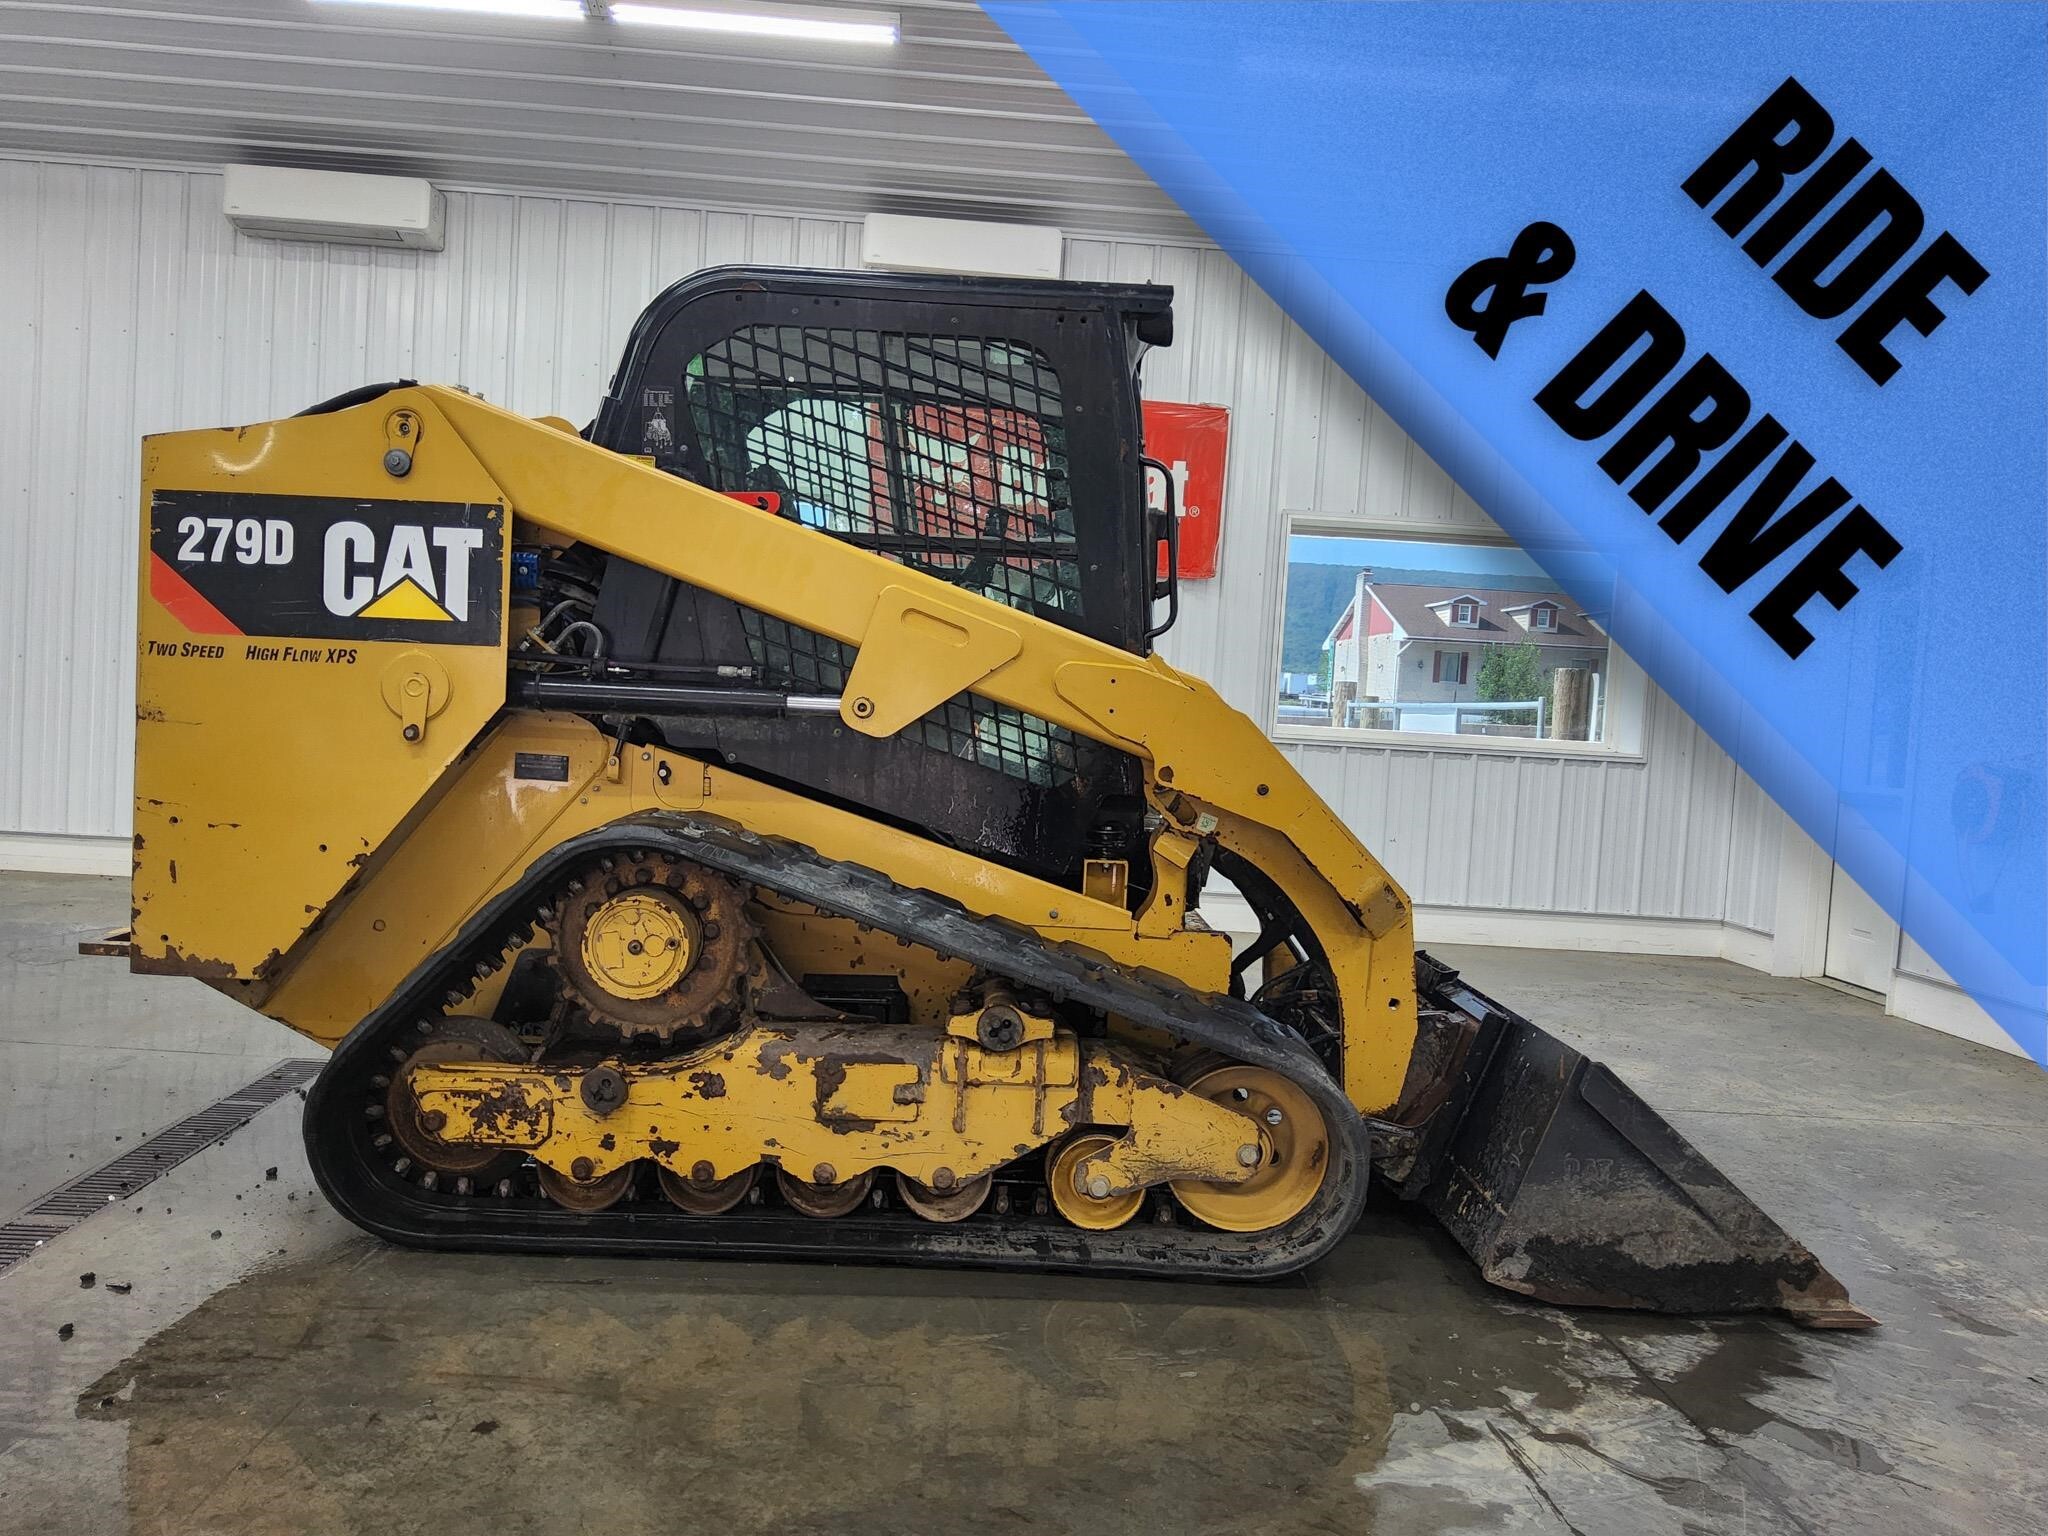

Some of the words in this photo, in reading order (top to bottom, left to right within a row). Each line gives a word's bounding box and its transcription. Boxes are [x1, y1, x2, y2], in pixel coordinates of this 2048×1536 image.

[176, 516, 295, 566] 279D
[322, 520, 484, 622] CAT
[148, 640, 178, 657] TWO
[180, 641, 225, 660] SPEED
[245, 644, 280, 662] HIGH
[282, 646, 323, 663] FLOW
[325, 647, 358, 665] XPS
